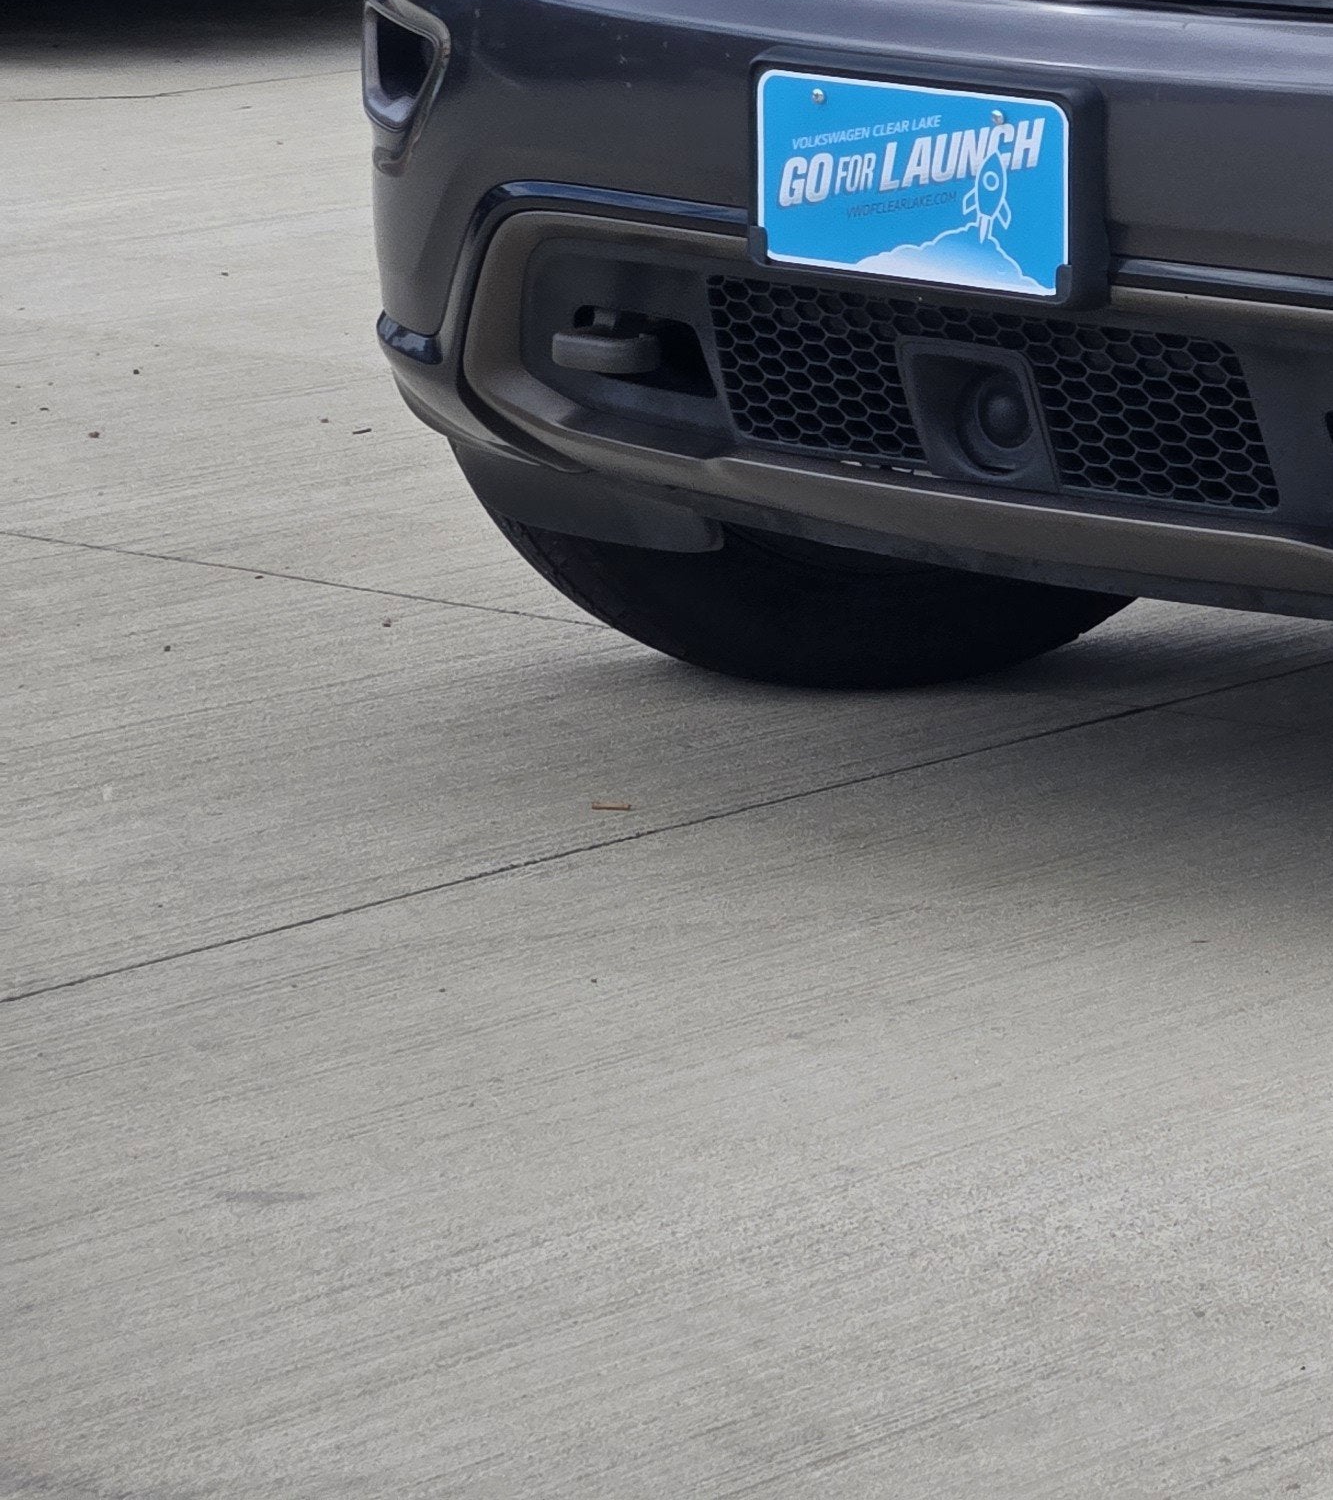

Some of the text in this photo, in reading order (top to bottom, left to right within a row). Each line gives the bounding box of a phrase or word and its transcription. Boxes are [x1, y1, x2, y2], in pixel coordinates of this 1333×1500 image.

[778, 117, 1046, 208] GO FOR LAUNCH
[792, 114, 942, 150] VOLKSWAGEN CLEAR LAKE
